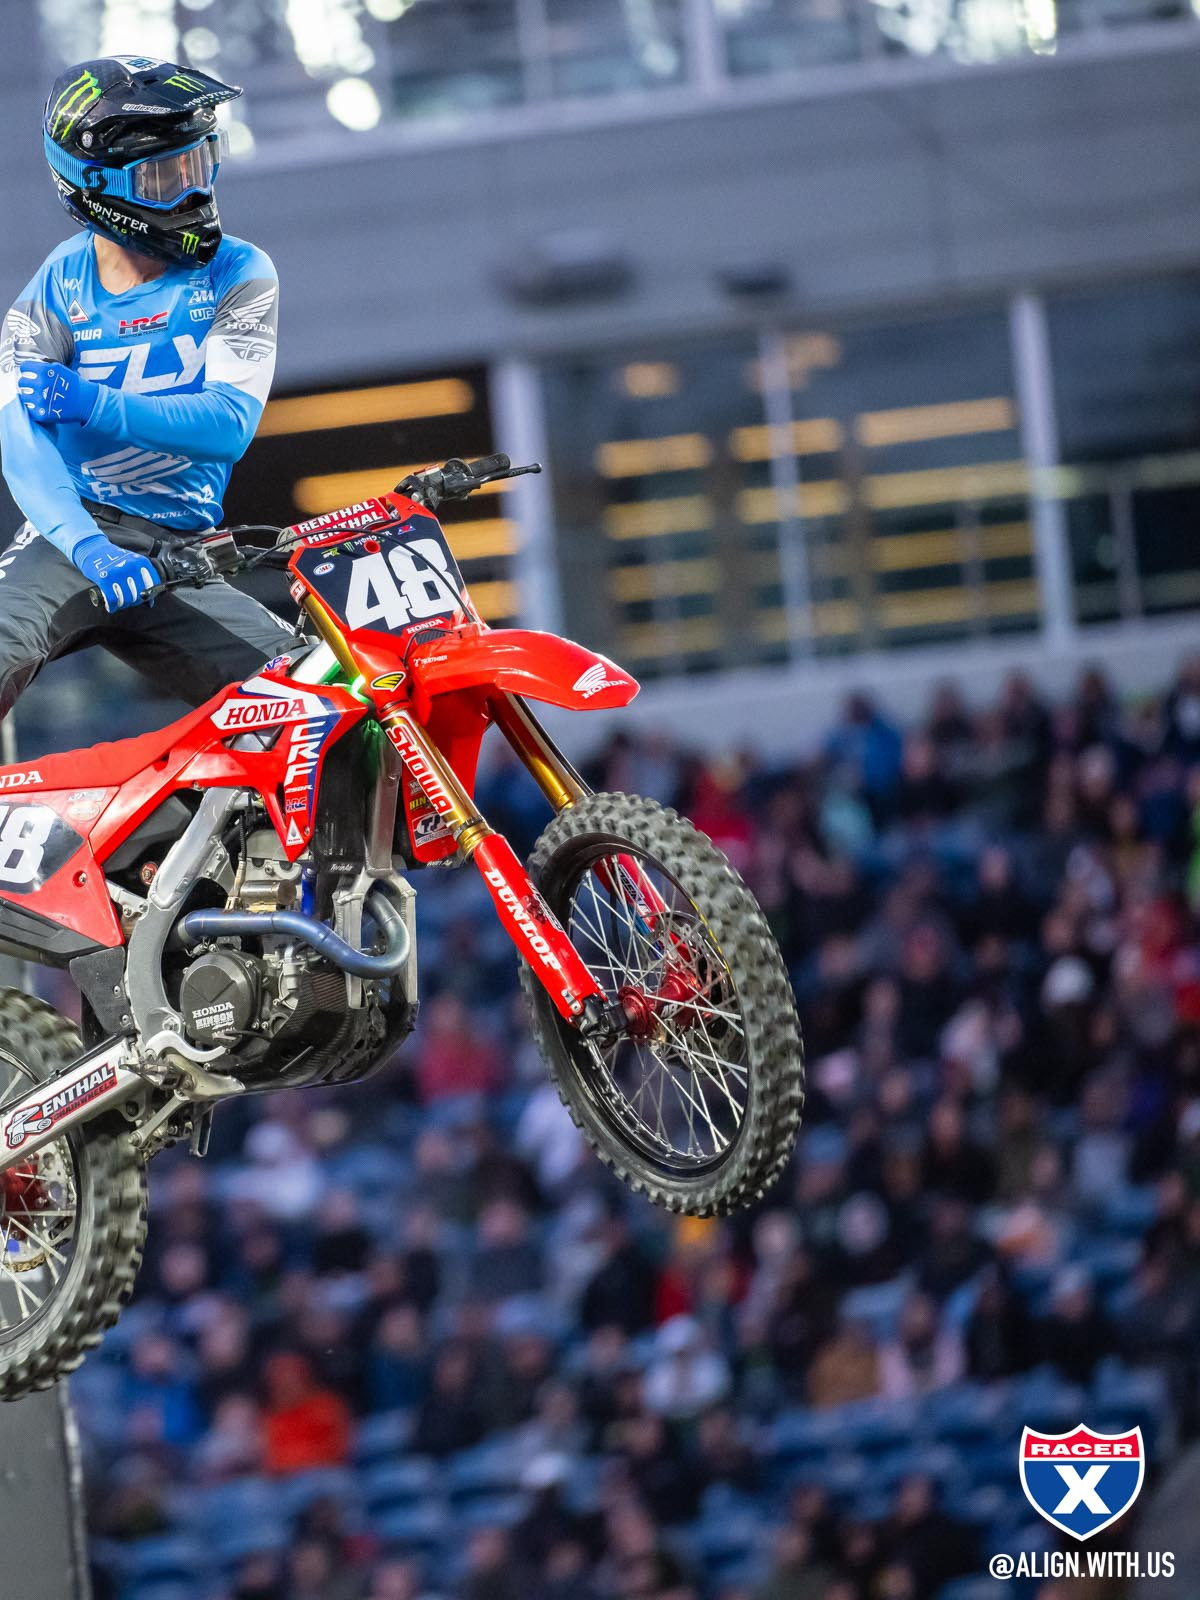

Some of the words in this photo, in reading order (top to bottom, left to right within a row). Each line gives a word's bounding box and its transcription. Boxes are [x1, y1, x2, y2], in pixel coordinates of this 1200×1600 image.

[82, 195, 149, 234] MONSTER
[73, 329, 102, 342] OWA
[118, 311, 169, 336] HRC
[224, 321, 275, 335] HONDA
[78, 334, 206, 394] FLY
[298, 500, 375, 534] RENTHAL
[345, 538, 458, 632] 48
[406, 618, 445, 634] HONDA
[582, 679, 629, 700] HONDA
[224, 698, 308, 726] HONDA
[284, 721, 326, 787] CRF
[385, 724, 455, 817] SHOWA
[484, 867, 561, 970] DUNLOP
[192, 1001, 235, 1019] HONDA
